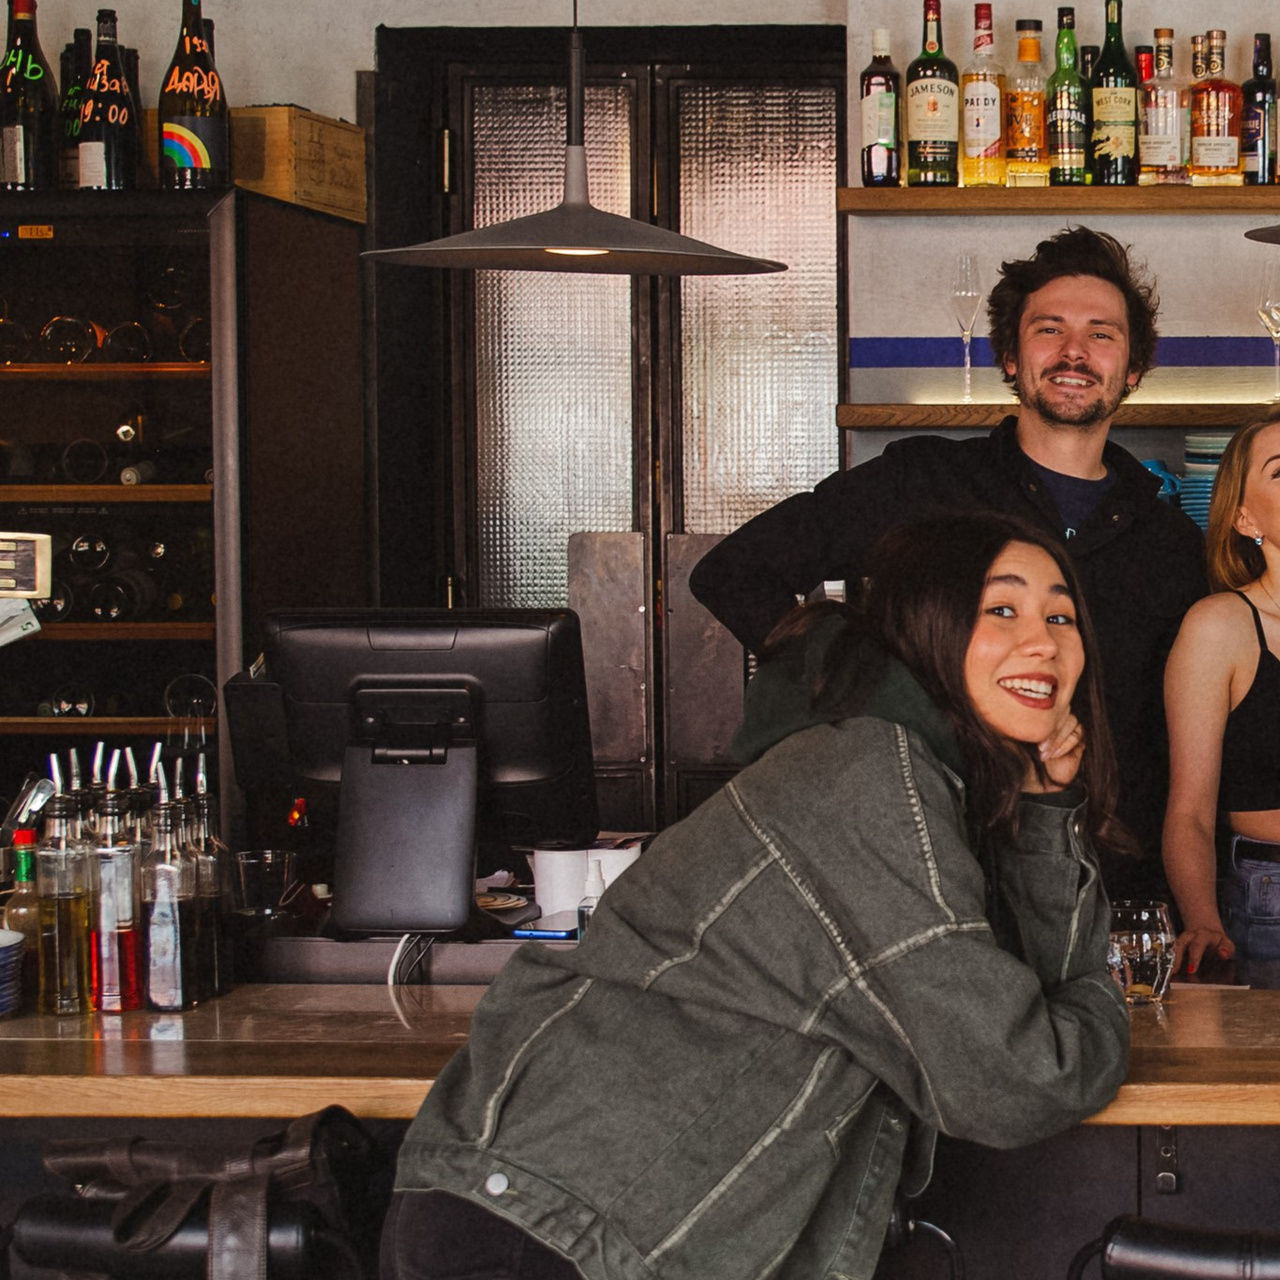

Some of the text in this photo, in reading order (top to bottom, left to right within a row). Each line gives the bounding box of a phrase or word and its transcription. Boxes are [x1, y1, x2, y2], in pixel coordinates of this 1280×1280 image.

[910, 83, 955, 98] JAMESON
[1096, 95, 1132, 107] WEST CORK
